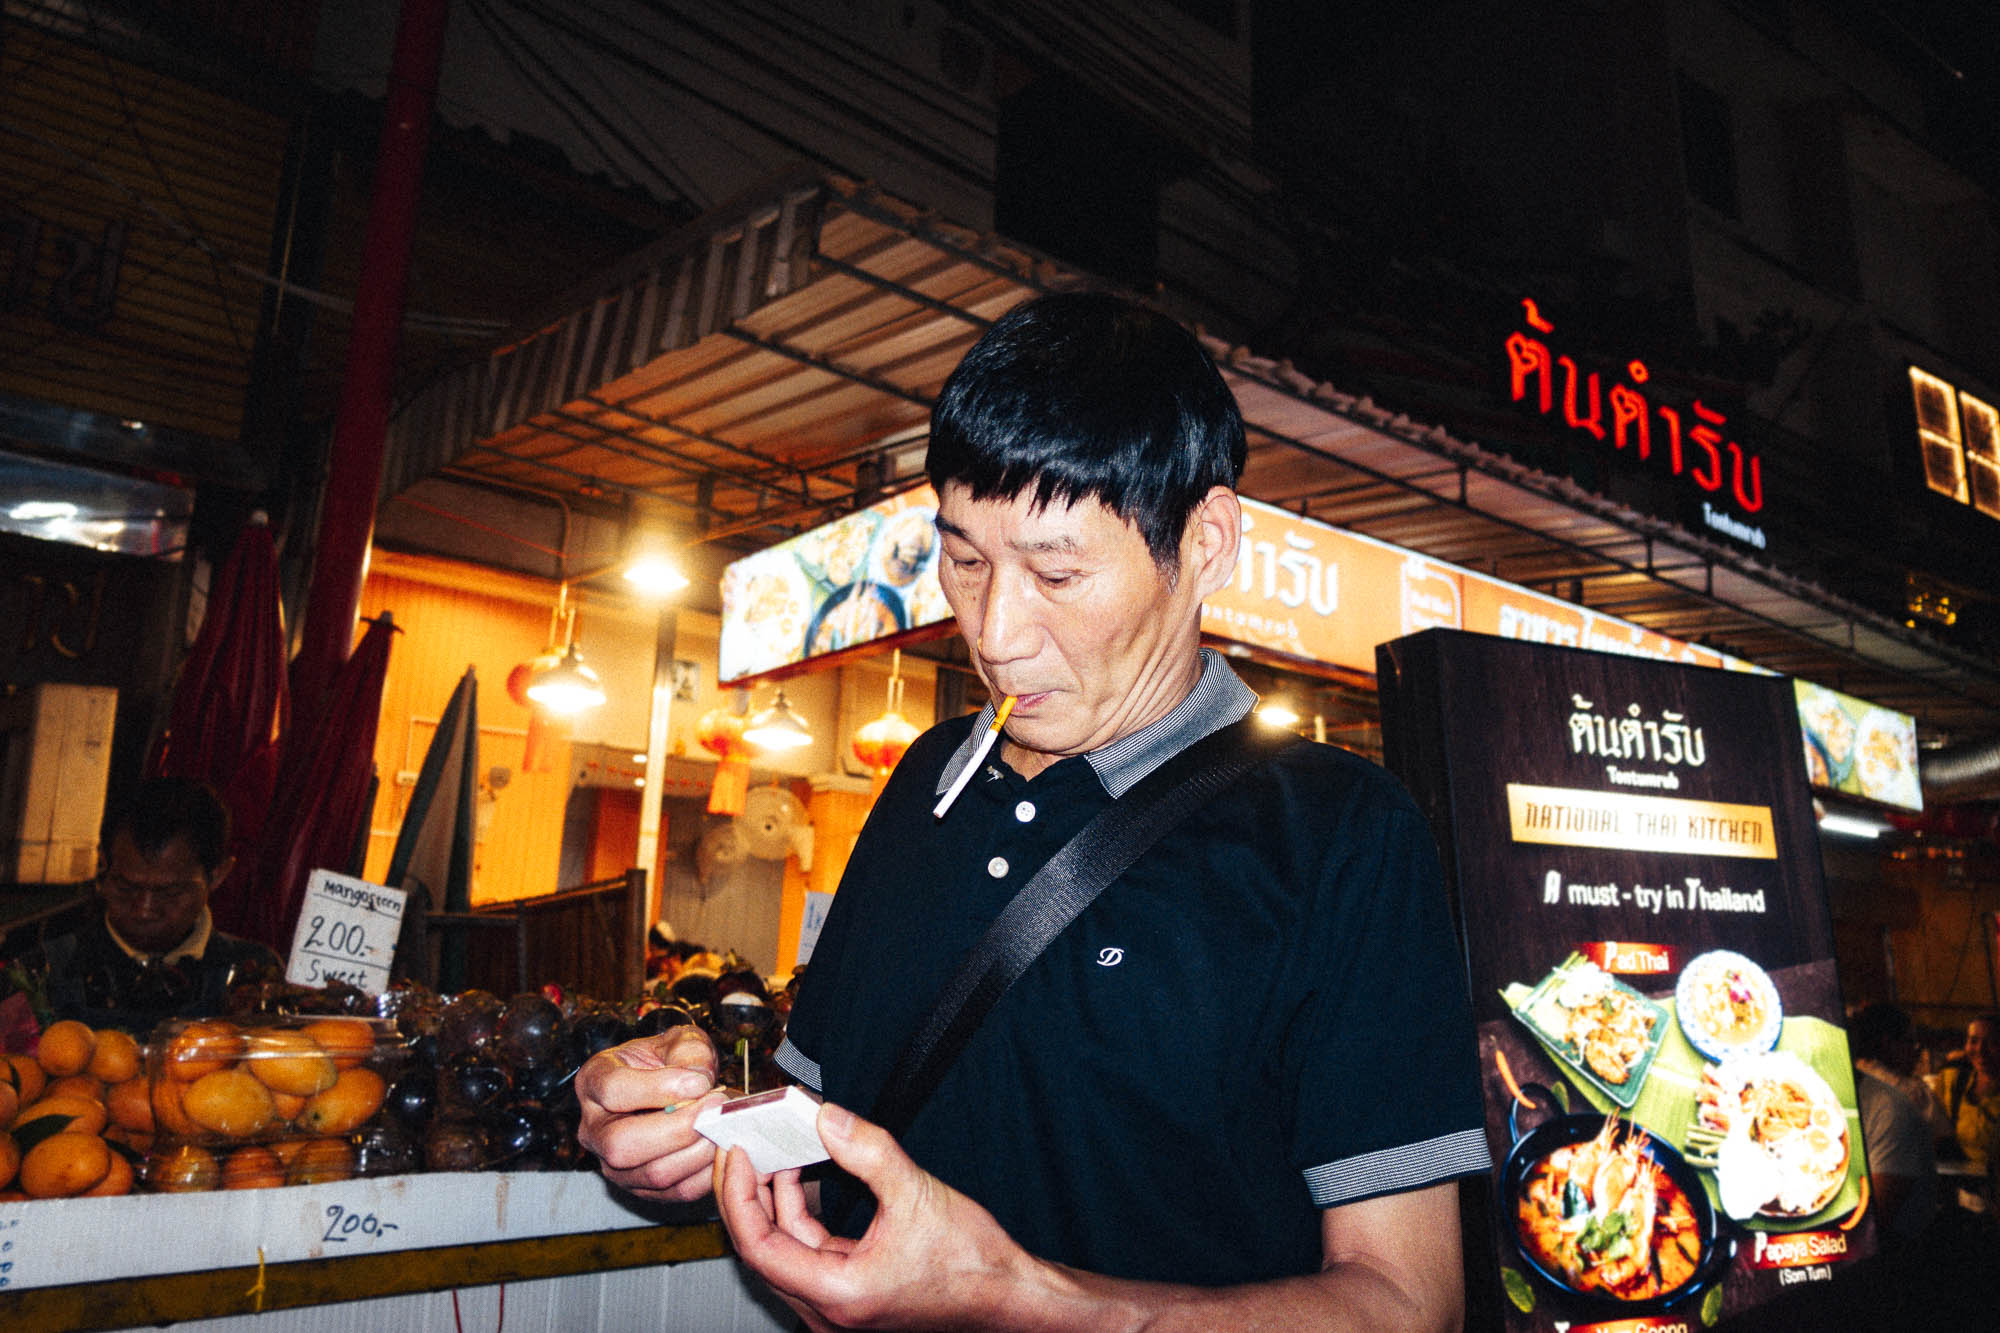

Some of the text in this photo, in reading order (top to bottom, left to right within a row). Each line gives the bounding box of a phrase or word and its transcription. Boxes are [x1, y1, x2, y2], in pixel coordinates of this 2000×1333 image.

[1506, 298, 1763, 513] ต้นตำรับ
[1568, 693, 1706, 767] ต้นตำรับ
[1525, 801, 1763, 845] NATIONAL THAI KITCHEN
[1544, 870, 1561, 904] A
[1665, 885, 1685, 910] in
[1685, 877, 1766, 913] Thailand
[1096, 947, 1125, 967] D
[1604, 941, 1670, 971] Pad Thai
[1754, 1230, 1847, 1265] Papaya Salad
